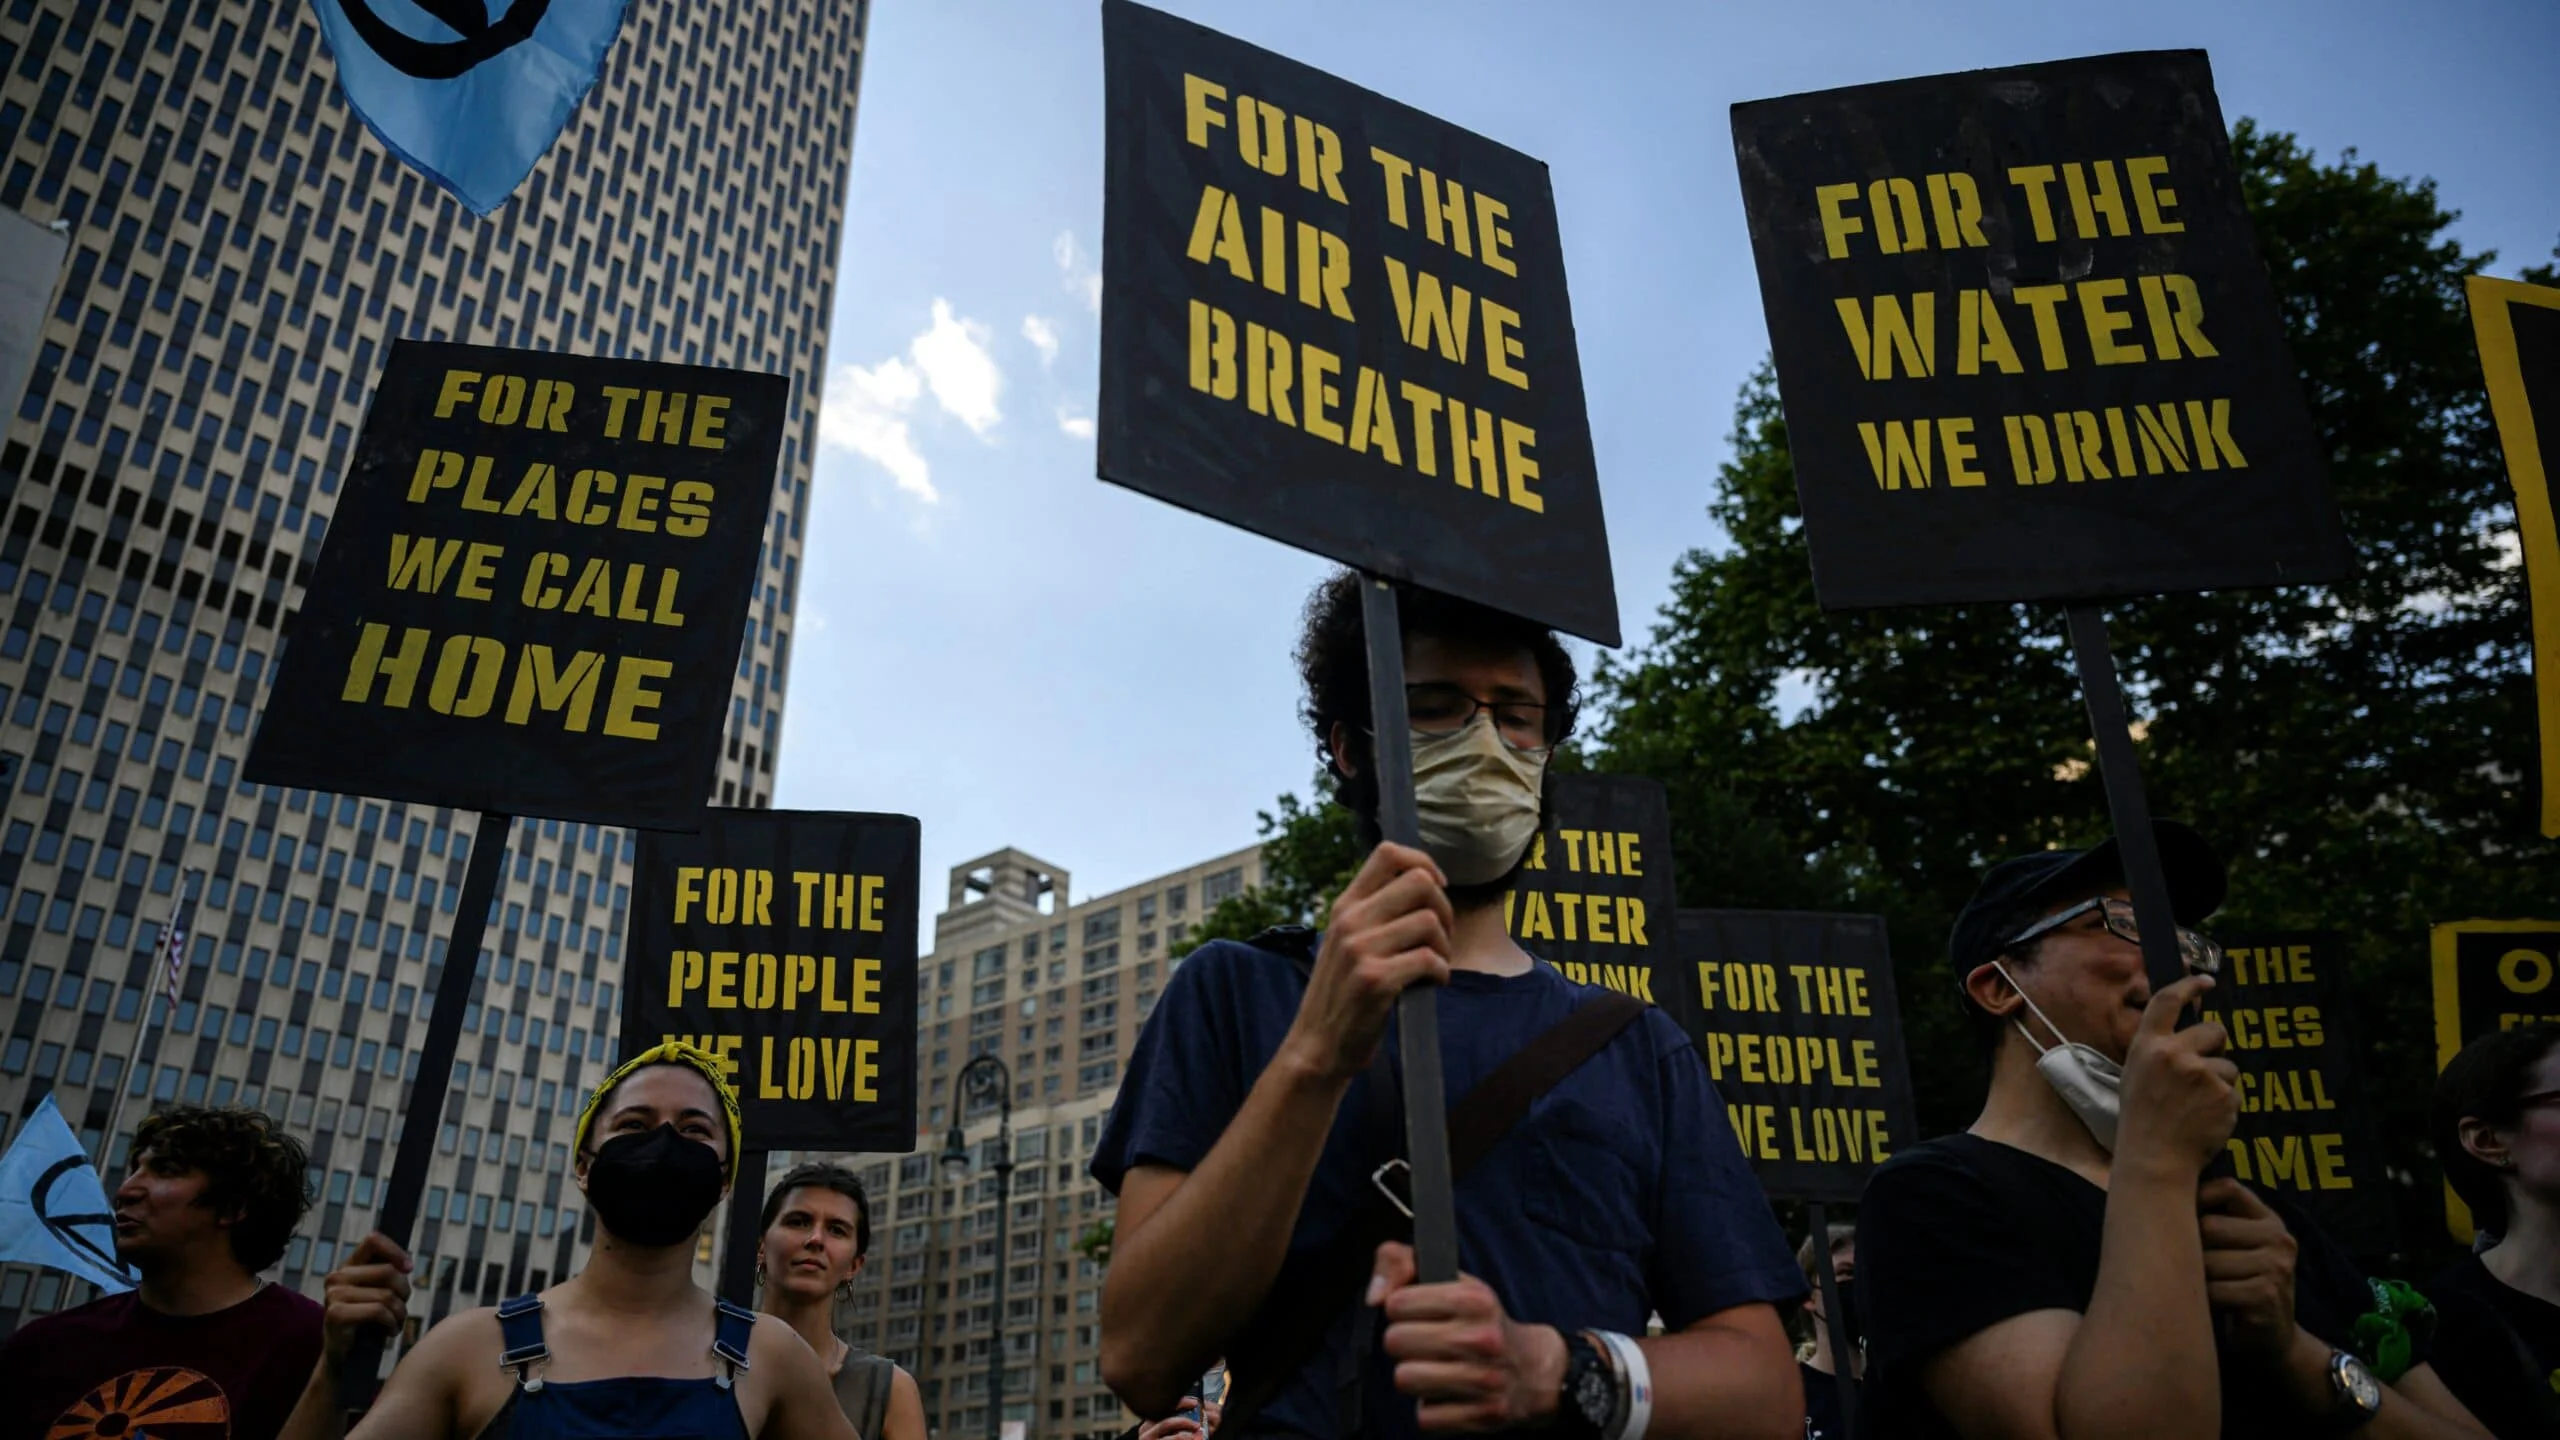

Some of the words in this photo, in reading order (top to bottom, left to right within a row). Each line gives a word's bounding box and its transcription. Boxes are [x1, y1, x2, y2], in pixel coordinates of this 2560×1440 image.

[1184, 73, 1349, 206] FOR
[1371, 147, 1518, 278] THE
[1815, 171, 1987, 260] FOR
[2008, 156, 2186, 242] THE
[1187, 185, 1356, 324] AIR
[1385, 256, 1531, 390] WE
[1835, 274, 2220, 381] WATER
[434, 370, 574, 432] FOR
[602, 386, 732, 450] THE
[1189, 299, 1545, 514] BREATHE
[1857, 417, 1986, 490] WE
[2004, 398, 2249, 486] DRINK
[407, 449, 715, 539] PLACES
[387, 534, 505, 602] WE
[522, 552, 685, 627] CALL
[342, 623, 674, 741] HOME
[1559, 829, 1643, 877] THE
[674, 867, 773, 926] FOR
[793, 871, 885, 932] THE
[668, 950, 882, 1014] PEOPLE
[1698, 961, 1781, 1012] FOR
[1789, 965, 1871, 1017] THE
[2226, 945, 2316, 985] THE
[662, 1034, 742, 1099] E
[759, 1036, 879, 1102] LOVE
[1707, 1032, 1881, 1088] PEOPLE
[2235, 1069, 2336, 1113] CALL
[1790, 1106, 1891, 1165] LOVE
